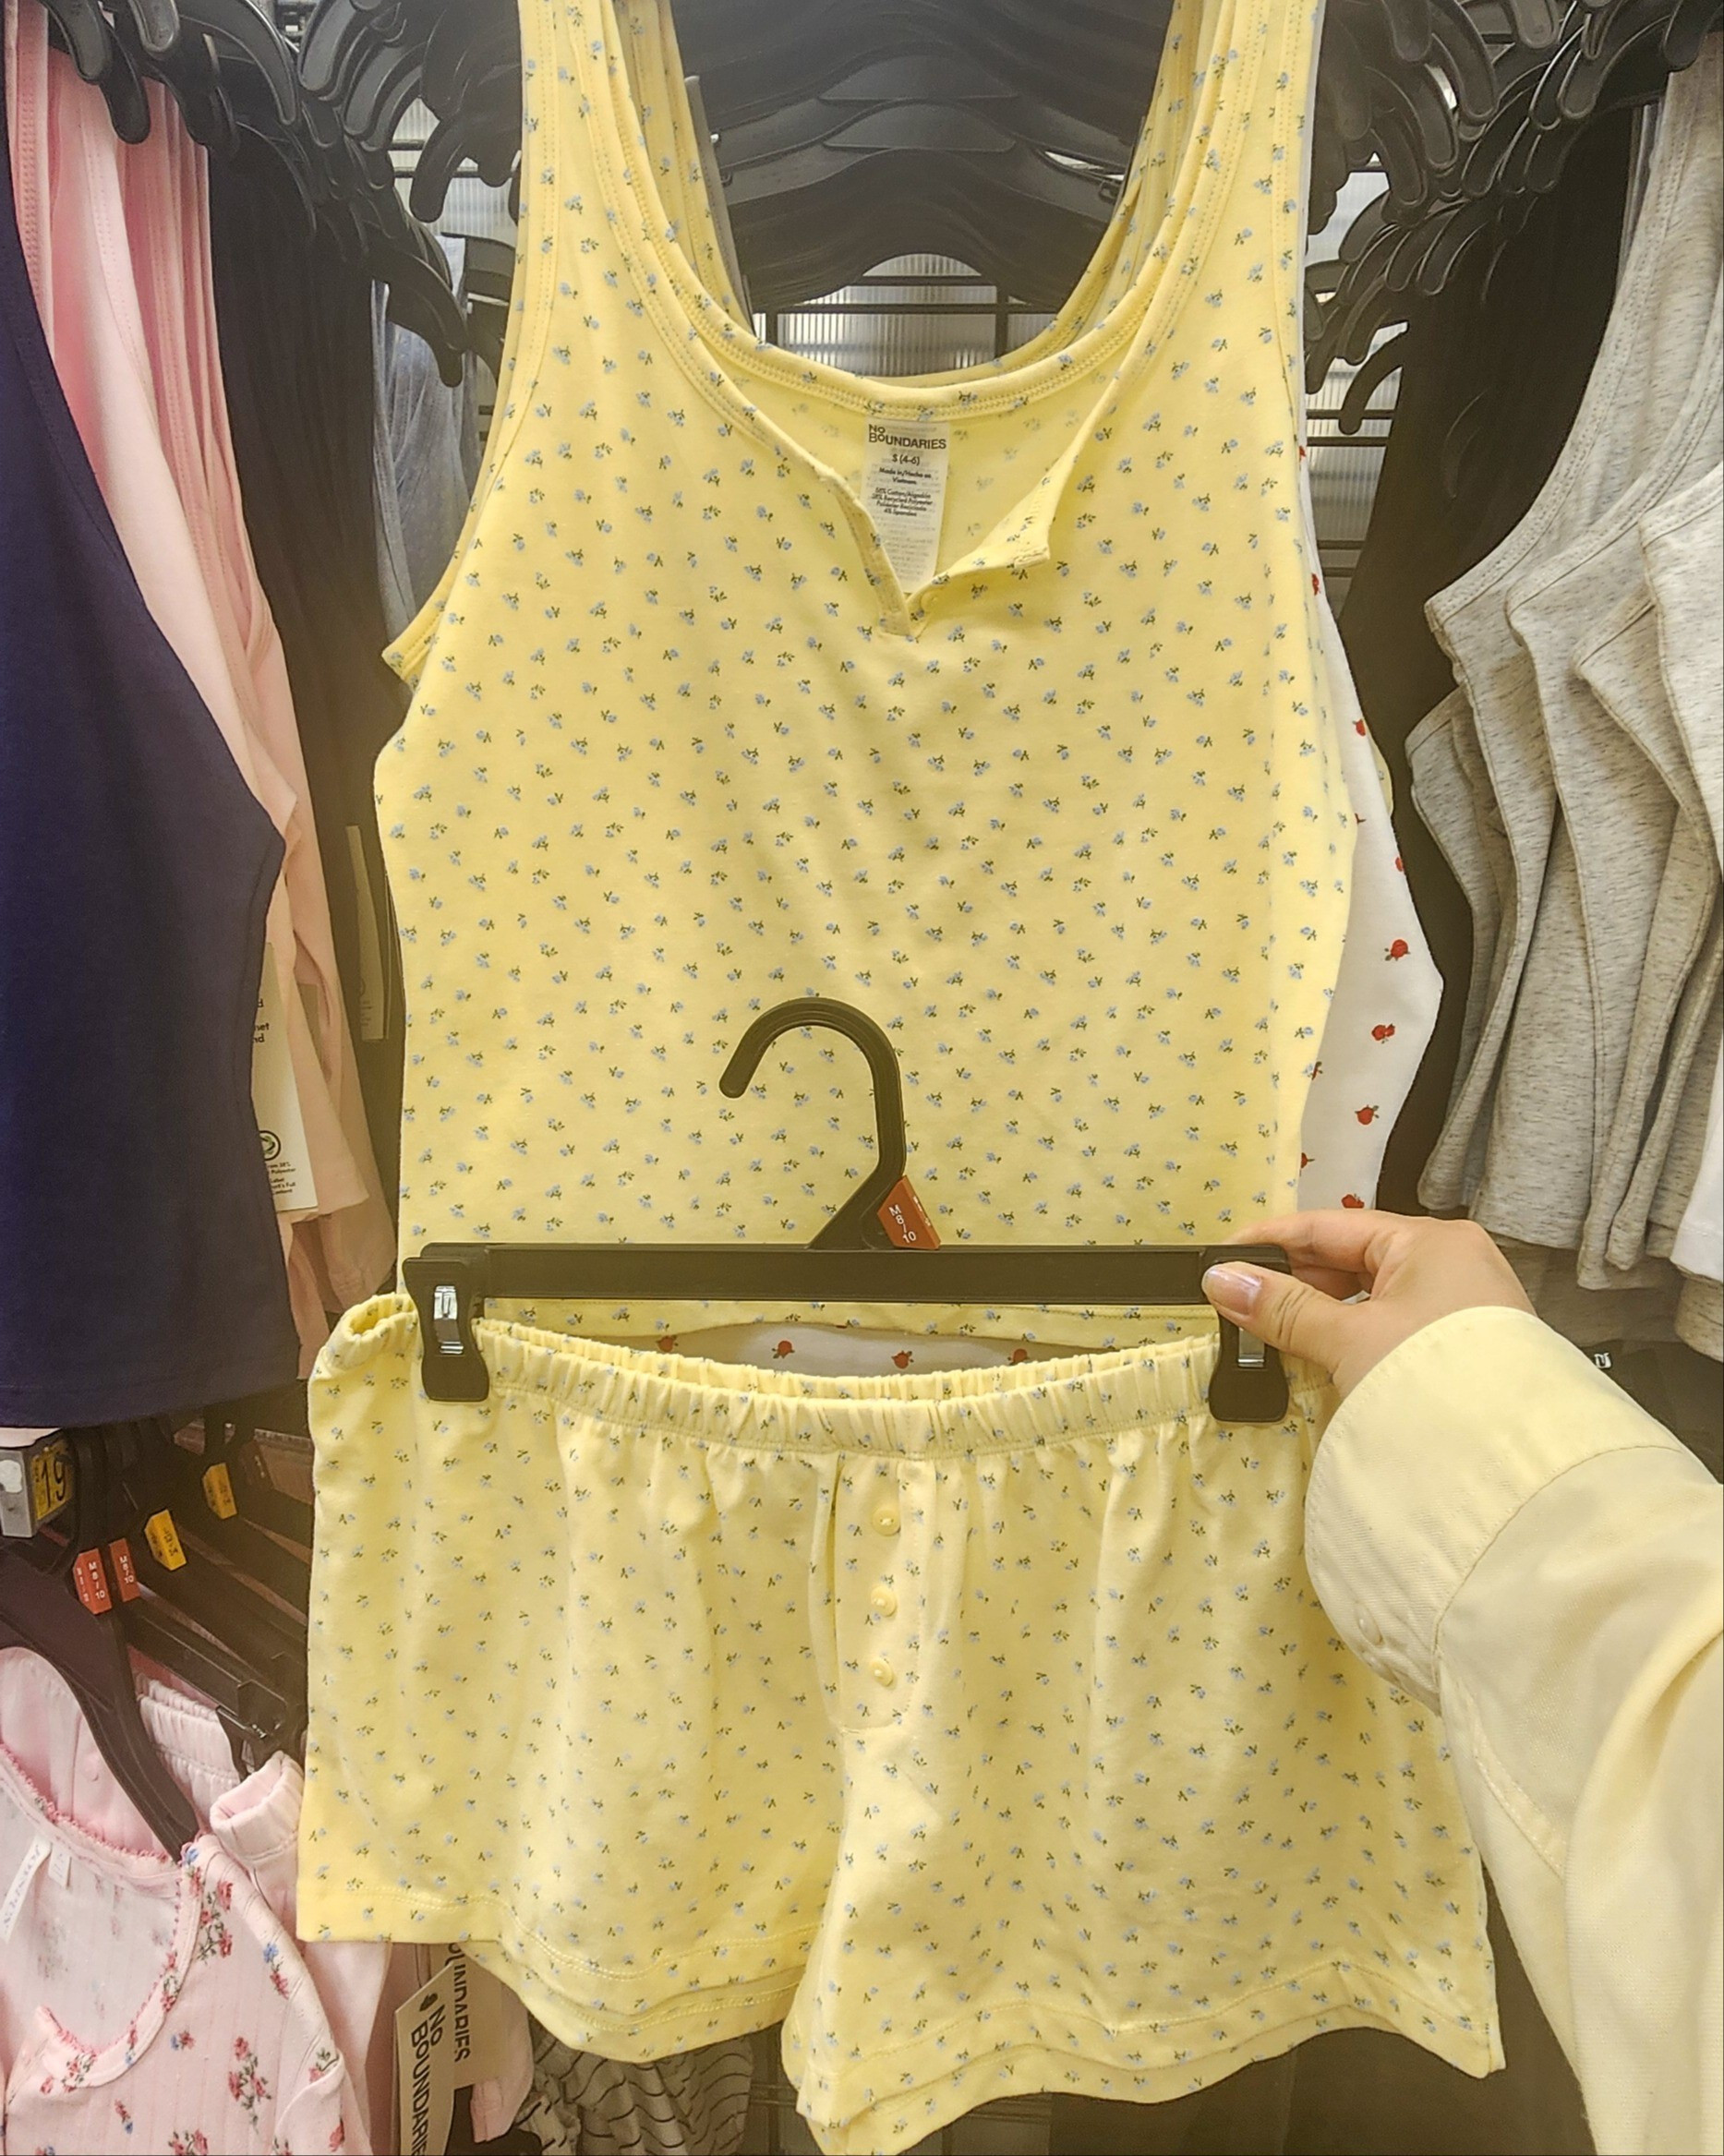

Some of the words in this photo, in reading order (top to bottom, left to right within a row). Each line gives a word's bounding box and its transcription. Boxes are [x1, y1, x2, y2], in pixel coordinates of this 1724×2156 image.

[868, 432, 946, 450] BOUNDARIES
[892, 453, 898, 463] S
[899, 454, 921, 466] (4-6)
[888, 1204, 901, 1216] M
[895, 1214, 904, 1224] 8
[902, 1231, 917, 1244] 10
[89, 1561, 97, 1571] M
[124, 1575, 135, 1584] 10
[95, 1590, 106, 1600] 10
